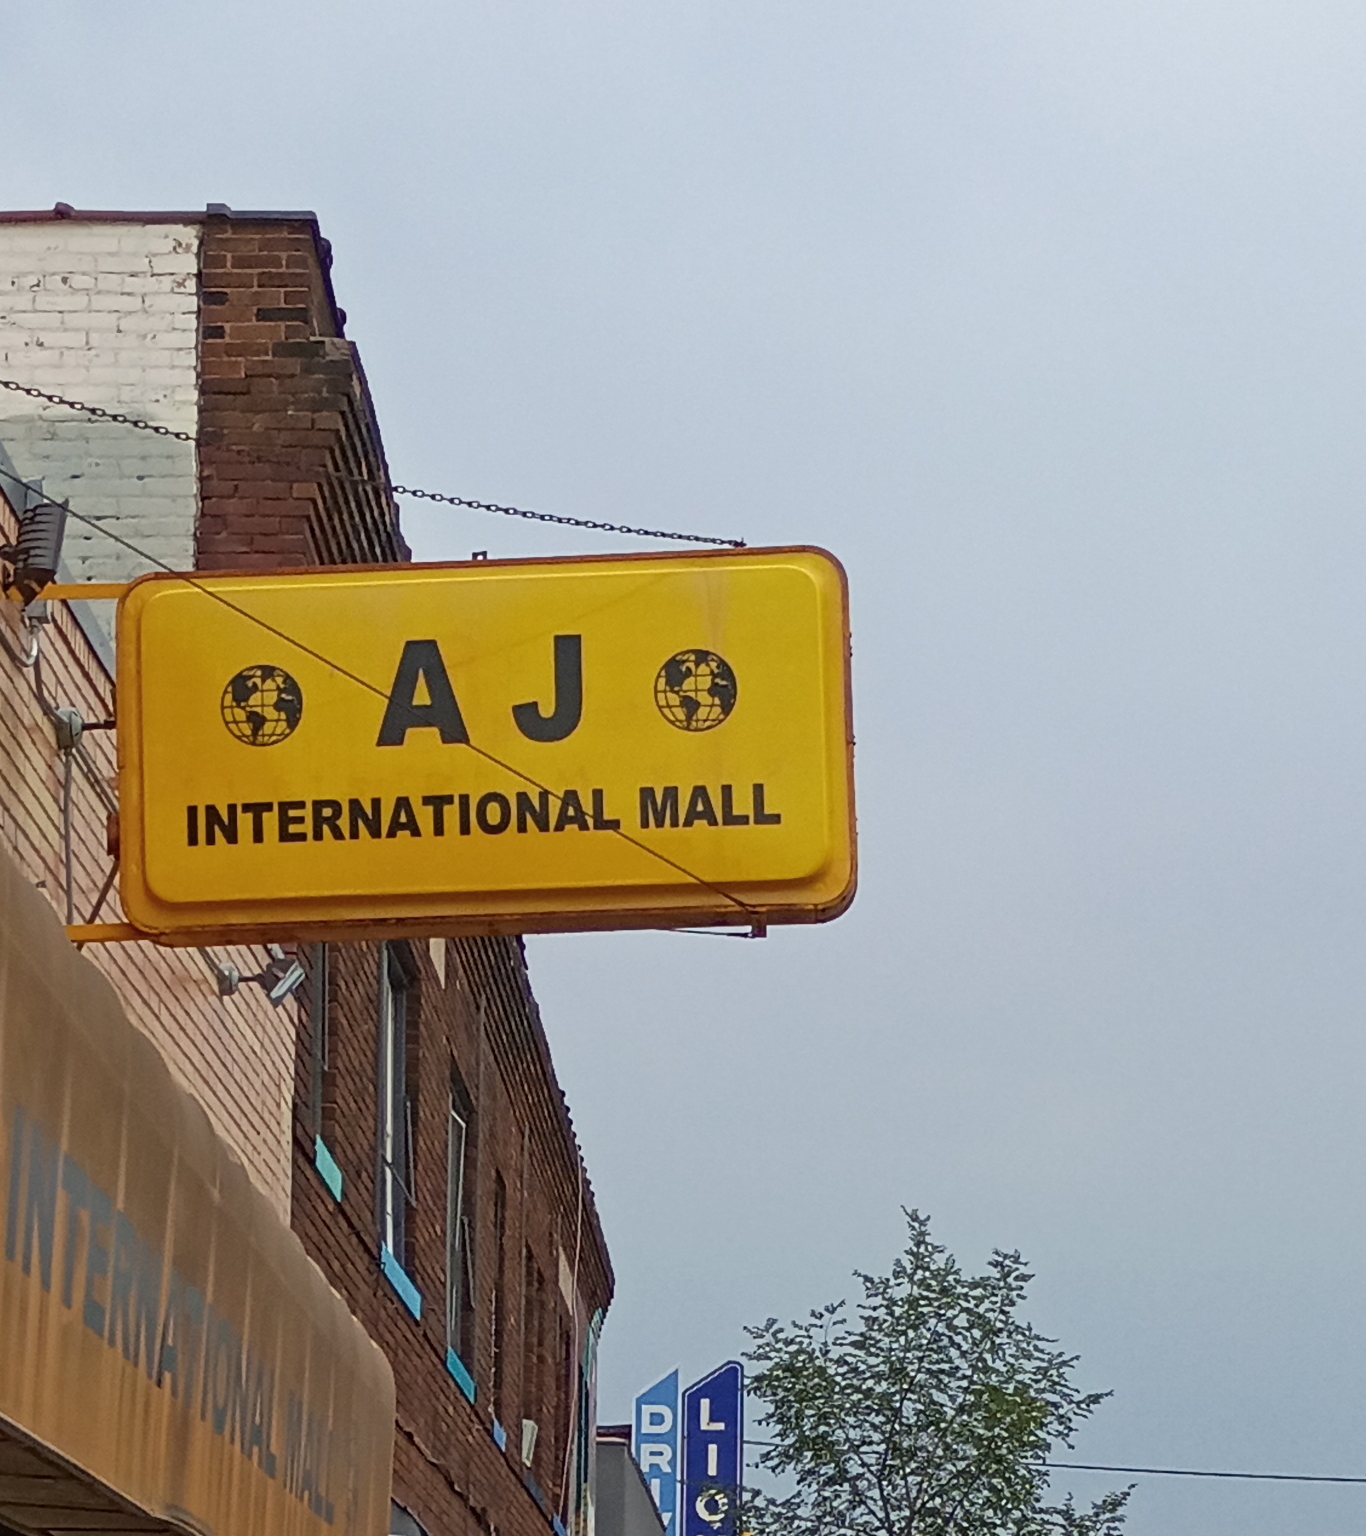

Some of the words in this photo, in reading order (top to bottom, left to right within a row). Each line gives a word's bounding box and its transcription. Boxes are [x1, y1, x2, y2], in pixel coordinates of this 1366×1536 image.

[376, 639, 471, 747] A
[512, 633, 583, 742] J
[186, 789, 621, 848] INTERNATIONAL
[640, 783, 782, 830] MALL
